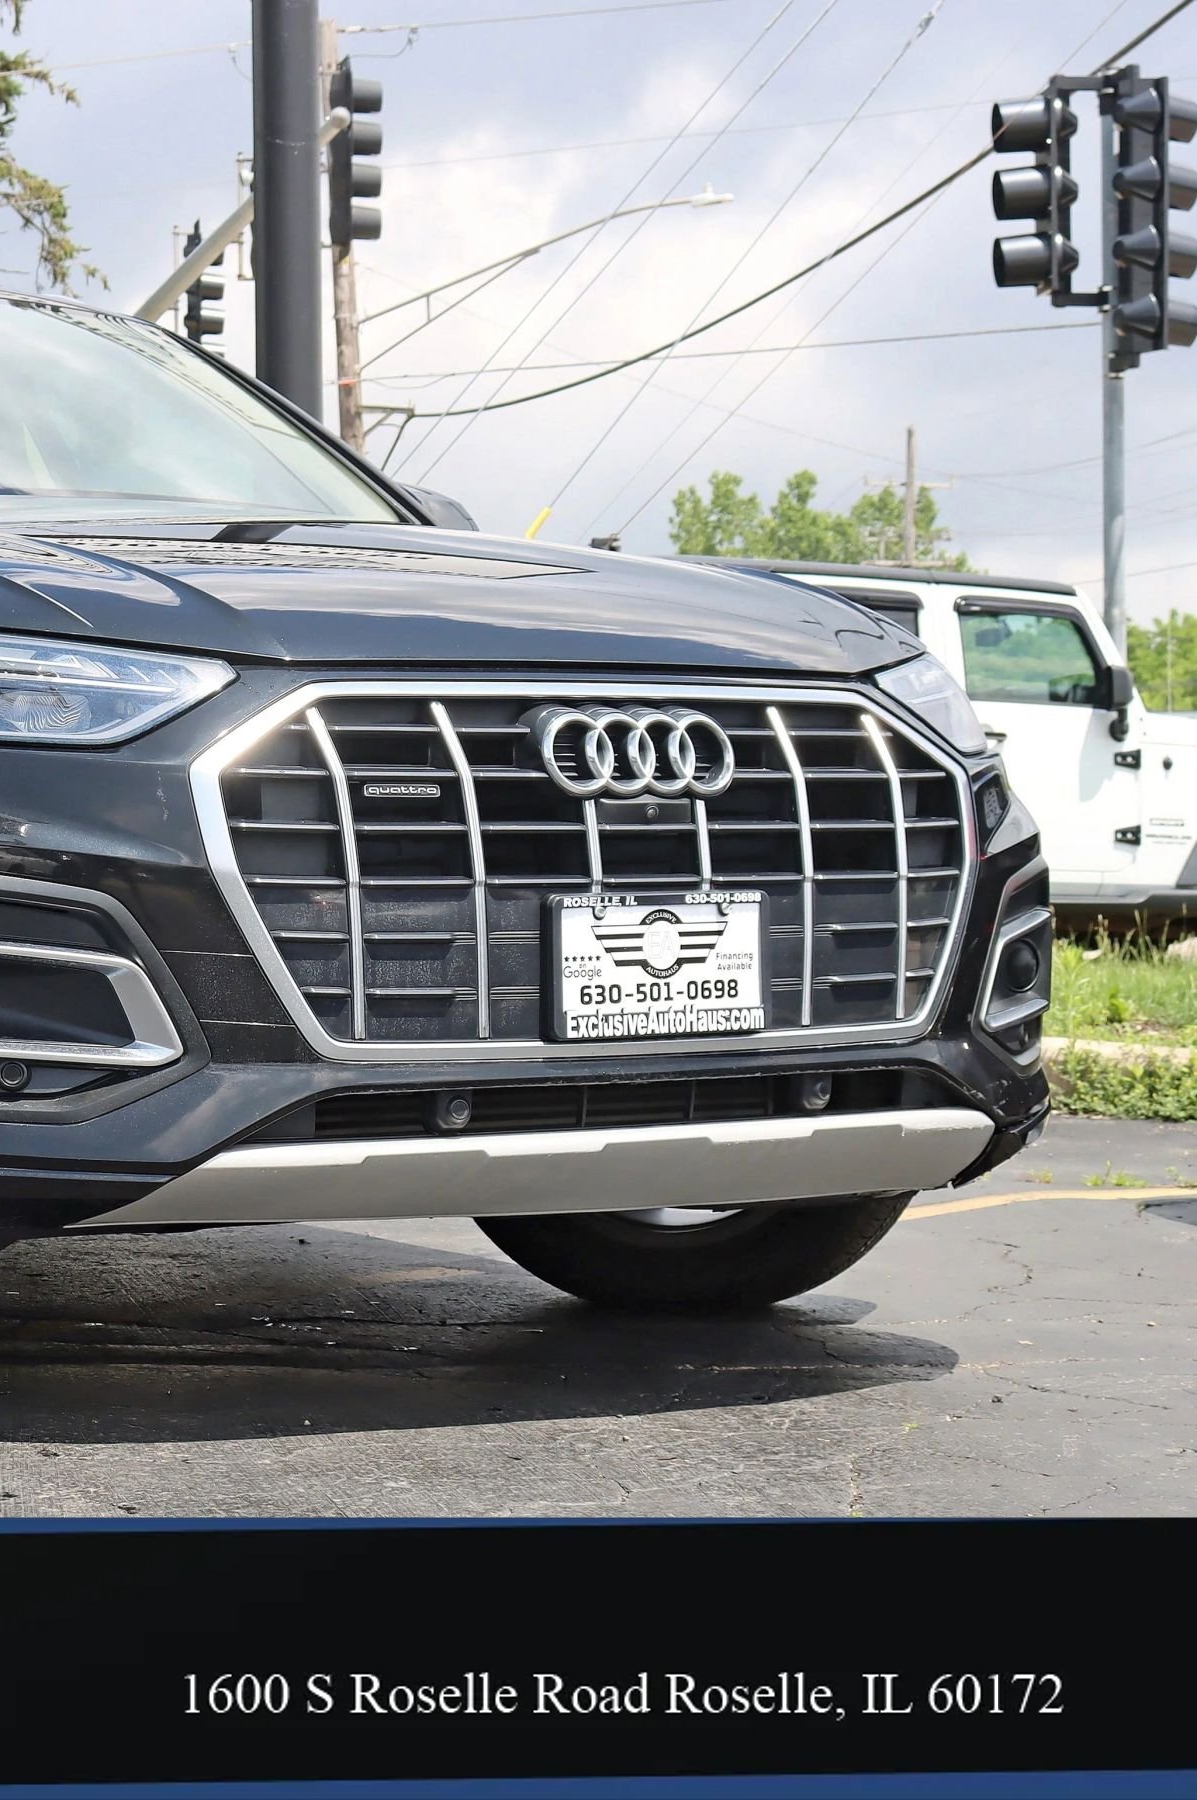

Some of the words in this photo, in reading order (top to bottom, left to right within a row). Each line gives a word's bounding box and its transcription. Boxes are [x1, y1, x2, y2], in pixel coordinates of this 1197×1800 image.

[367, 785, 438, 796] quattro
[563, 896, 622, 908] ROSELLE,
[625, 895, 638, 906] IL
[684, 892, 762, 904] 630-501-0698
[645, 911, 678, 925] EXCLUSIVE
[715, 951, 754, 962] Financing
[563, 965, 602, 981] Google
[645, 963, 680, 978] AUTOHAUS
[716, 962, 753, 971] Available
[579, 979, 739, 1006] 630-501-0698
[566, 1004, 766, 1038] ExclusiveAutoHaus.com
